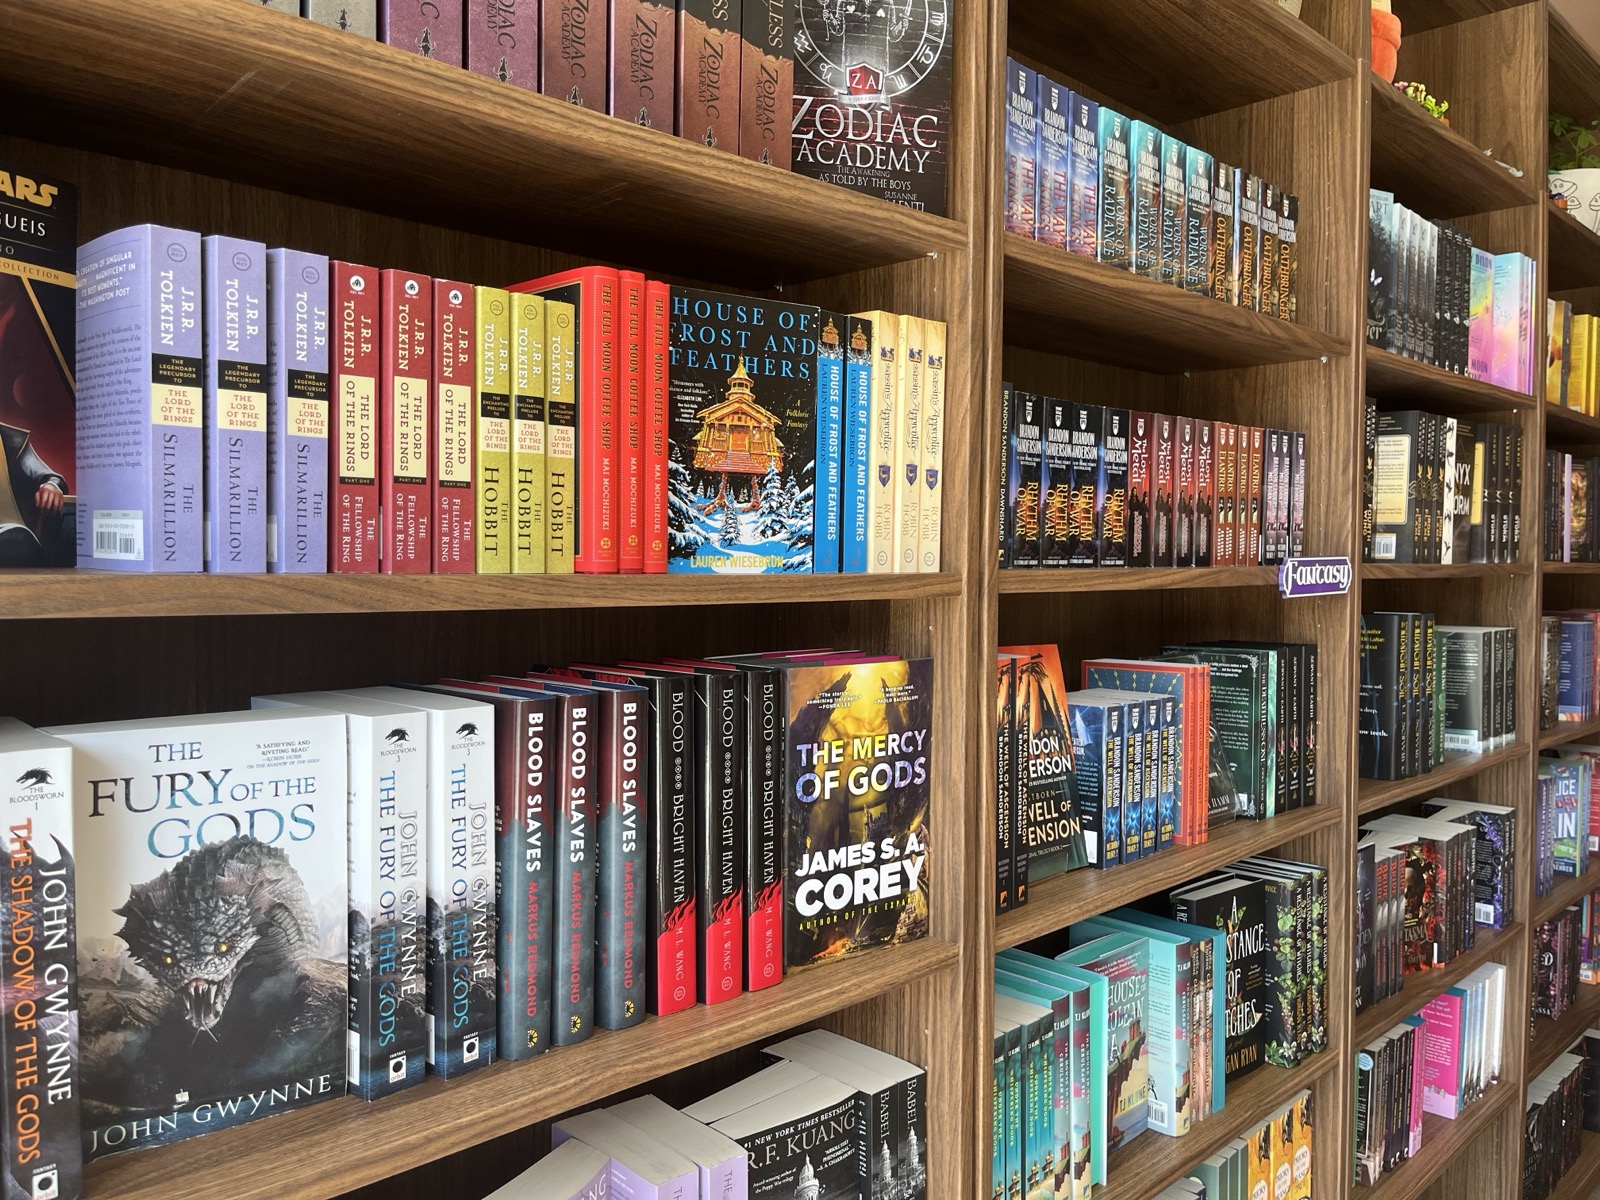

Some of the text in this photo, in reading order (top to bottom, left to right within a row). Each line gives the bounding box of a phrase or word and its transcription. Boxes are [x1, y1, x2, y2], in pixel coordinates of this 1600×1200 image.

[792, 94, 939, 148] ZODIAC
[796, 141, 931, 173] ACADEMY
[838, 165, 890, 178] THE AWAKENING
[819, 173, 911, 191] AS TOLD BY THE BOYS
[885, 191, 917, 200] SUSANNE
[1103, 185, 1115, 257] RADIANCE
[1216, 217, 1226, 300] OATHBRINGER
[161, 270, 173, 345] TOLKIEN
[182, 287, 194, 332] J.R.R.
[673, 297, 810, 331] HOUSE OF
[485, 323, 494, 386] TOLKIEN
[669, 322, 816, 356] FROST AND
[160, 364, 196, 372] LEGENDARY
[602, 283, 611, 451] THE FULL MOON COFFEE SHOP
[671, 348, 810, 379] FEATHERS
[163, 415, 193, 423] RINGS
[165, 398, 191, 406] LORD
[346, 380, 355, 472] OF THE RINGS
[361, 395, 369, 460] THE LORD
[1020, 424, 1039, 438] BRANDON
[1132, 437, 1142, 483] Metal
[164, 433, 178, 562] SILMARILLION
[184, 484, 194, 513] THE
[230, 438, 243, 562] SILMARILLION
[343, 494, 350, 509] OF
[485, 466, 499, 556] HOBBIT
[519, 468, 533, 555] HOBBIT
[1016, 487, 1027, 537] OF WAR
[1026, 482, 1038, 541] RHYTHM
[1055, 483, 1068, 542] RHYTHM
[367, 518, 375, 541] THE
[690, 555, 784, 569] LAUREN WIESEBRON
[1287, 560, 1350, 594] Fantasy
[149, 742, 202, 763] THE
[797, 729, 926, 766] THE MERCY
[9, 792, 64, 803] BLOODSWORN
[88, 768, 316, 818] FURY OF THE
[526, 712, 543, 872] BLOOD SLAVES
[672, 692, 685, 902] BLOOD BRIGHT HAVEN
[795, 757, 926, 803] OF GODS
[1004, 776, 1009, 788] OF
[1060, 800, 1071, 813] OF
[147, 804, 316, 859] GODS
[795, 832, 924, 876] JAMES S. A.
[795, 856, 925, 916] COREY
[800, 906, 877, 930] AUTHOR OF THE
[1232, 896, 1237, 923] A
[526, 882, 537, 1017] MARKUS REDMOND
[1226, 923, 1264, 964] STANCE
[38, 867, 72, 1106] JOHN GWYNNE
[675, 953, 683, 981] WANG
[1228, 968, 1241, 999] OF
[10, 817, 41, 1164] THE SHADOW OF THE GODS
[1241, 1044, 1257, 1067] RYAN
[90, 1074, 331, 1153] JOHN GWYNNE
[881, 1090, 890, 1143] BABEL
[1119, 1087, 1146, 1112] TJ KLUNE
[748, 1109, 855, 1172] R.F. KUANG
[755, 1100, 855, 1145] NEW YORK TIMES BESTSELLER
